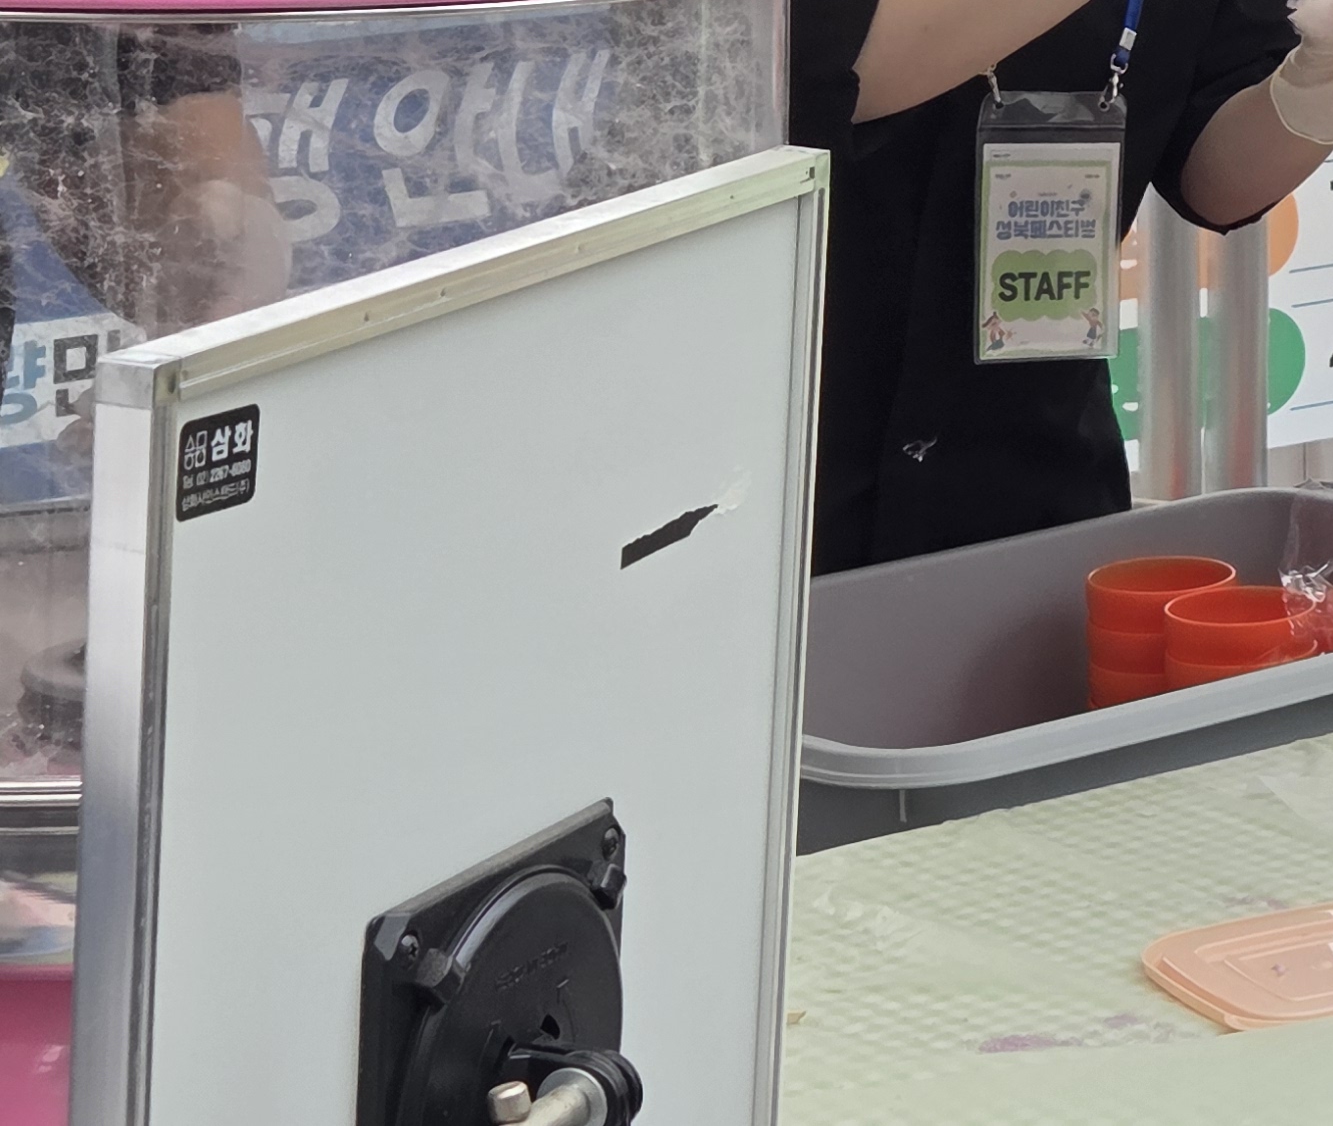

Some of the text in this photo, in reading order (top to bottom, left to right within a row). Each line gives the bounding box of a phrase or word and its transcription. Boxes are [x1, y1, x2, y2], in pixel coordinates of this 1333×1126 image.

[1007, 199, 1086, 218] 어린이친구
[995, 219, 1097, 241] 성북페스티벌
[997, 270, 1091, 303] STAFF
[210, 419, 254, 462] 삼화
